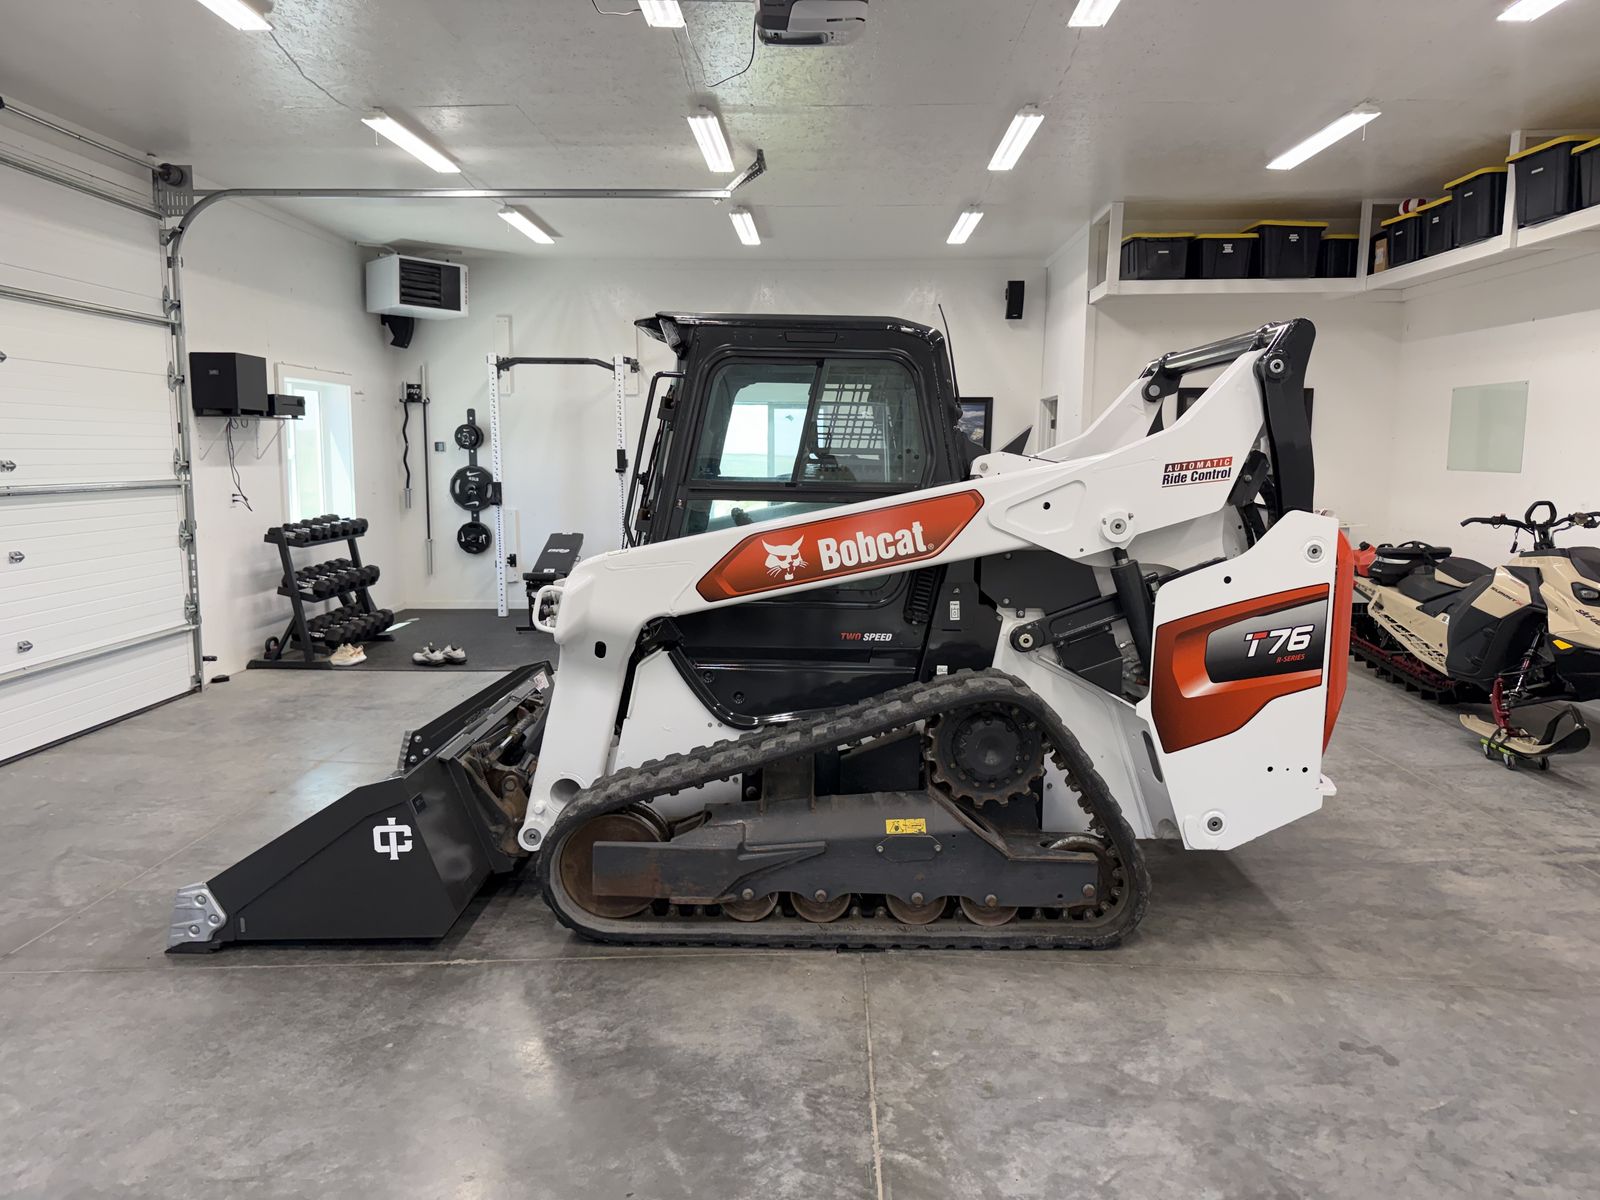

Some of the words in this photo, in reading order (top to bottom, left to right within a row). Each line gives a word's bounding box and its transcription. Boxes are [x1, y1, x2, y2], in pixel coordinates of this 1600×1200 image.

[1167, 458, 1230, 472] AUTOMATIC
[1162, 472, 1187, 485] Ride
[1190, 467, 1231, 482] Control
[817, 521, 927, 572] Bobcat
[841, 632, 862, 640] TWO
[863, 633, 893, 641] SPEED
[1245, 625, 1314, 657] T76
[1276, 653, 1305, 663] R-SERIES
